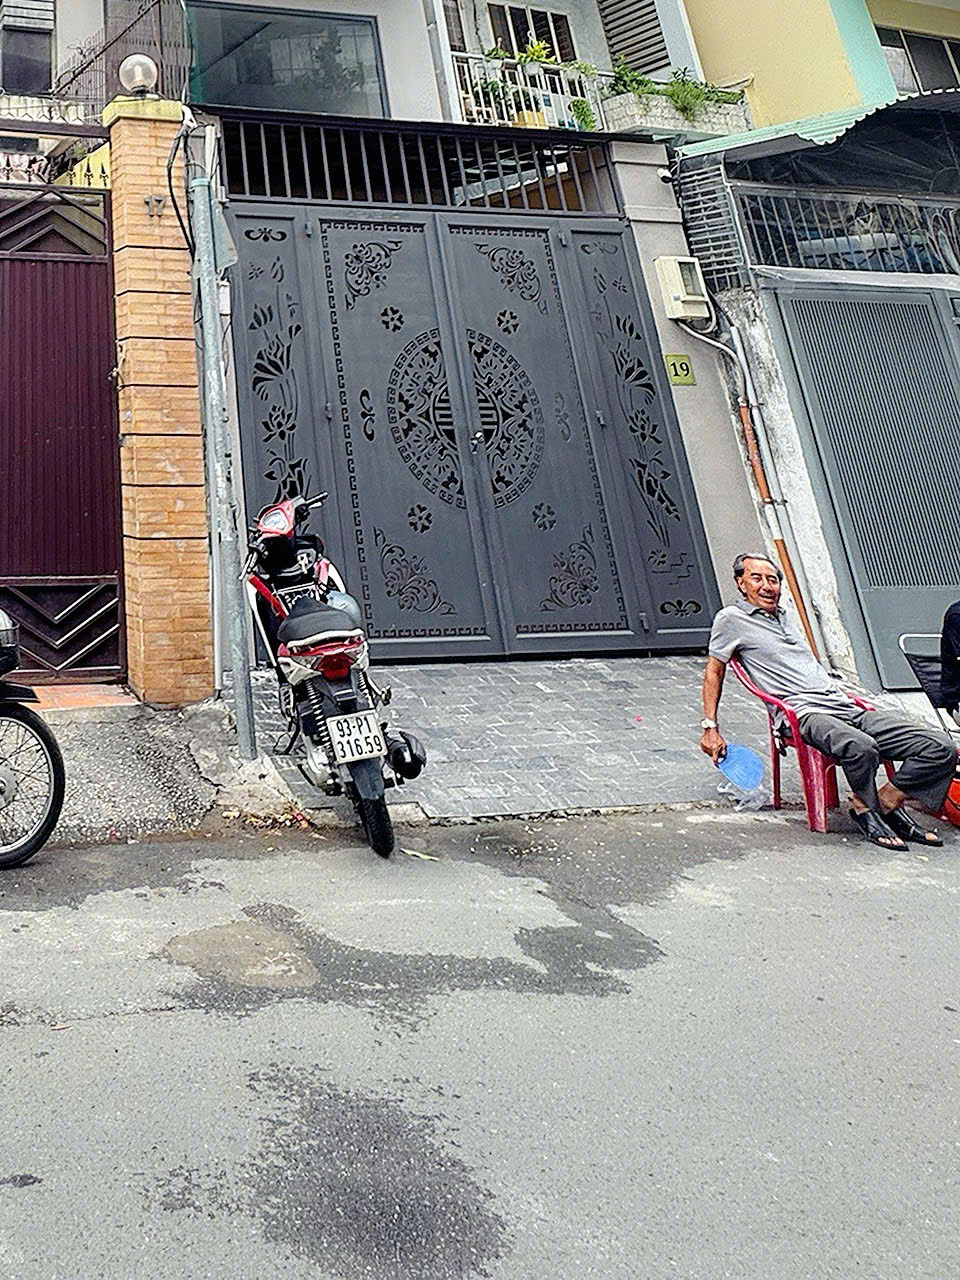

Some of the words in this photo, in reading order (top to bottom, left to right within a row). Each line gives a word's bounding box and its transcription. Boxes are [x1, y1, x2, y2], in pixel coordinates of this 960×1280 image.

[144, 194, 166, 217] 17
[670, 362, 690, 377] 19
[336, 716, 372, 738] 93-P1
[337, 735, 383, 758] 316.59
